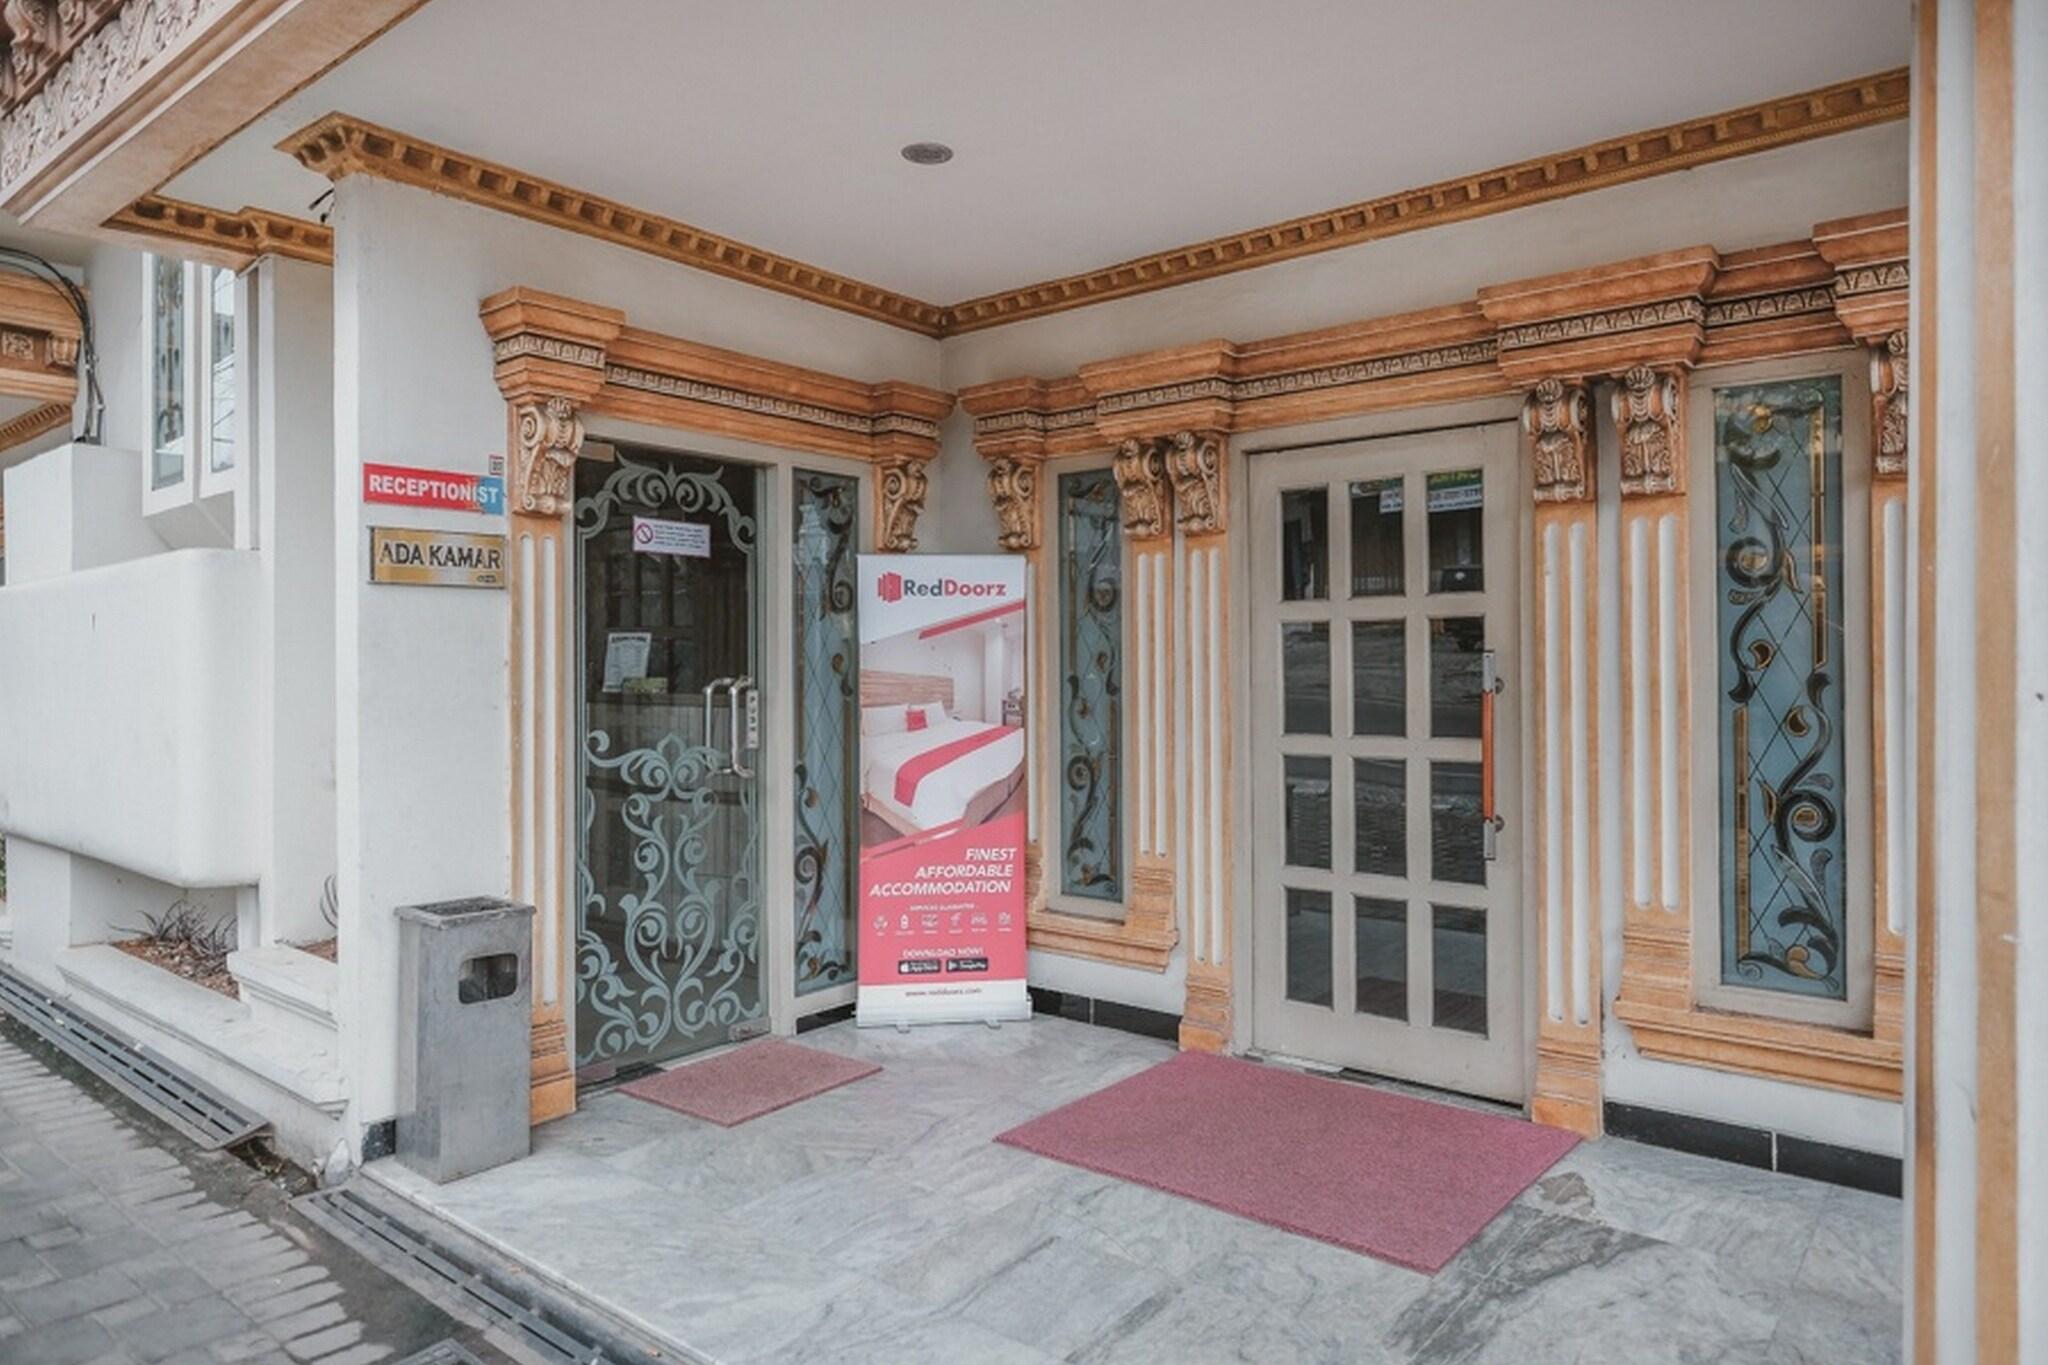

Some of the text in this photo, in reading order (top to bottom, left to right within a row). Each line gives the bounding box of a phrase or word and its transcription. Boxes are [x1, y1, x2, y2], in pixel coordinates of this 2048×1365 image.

[369, 474, 499, 503] RECEPTIONIST
[379, 541, 502, 569] ADA KAMAR
[903, 578, 1007, 597] RedDoorz
[965, 847, 1017, 861] FINEST
[914, 864, 1014, 879] AFFORDABLE
[868, 880, 1012, 897] ACCOMMODATION
[903, 946, 984, 958] DOWNLOAD NOW!
